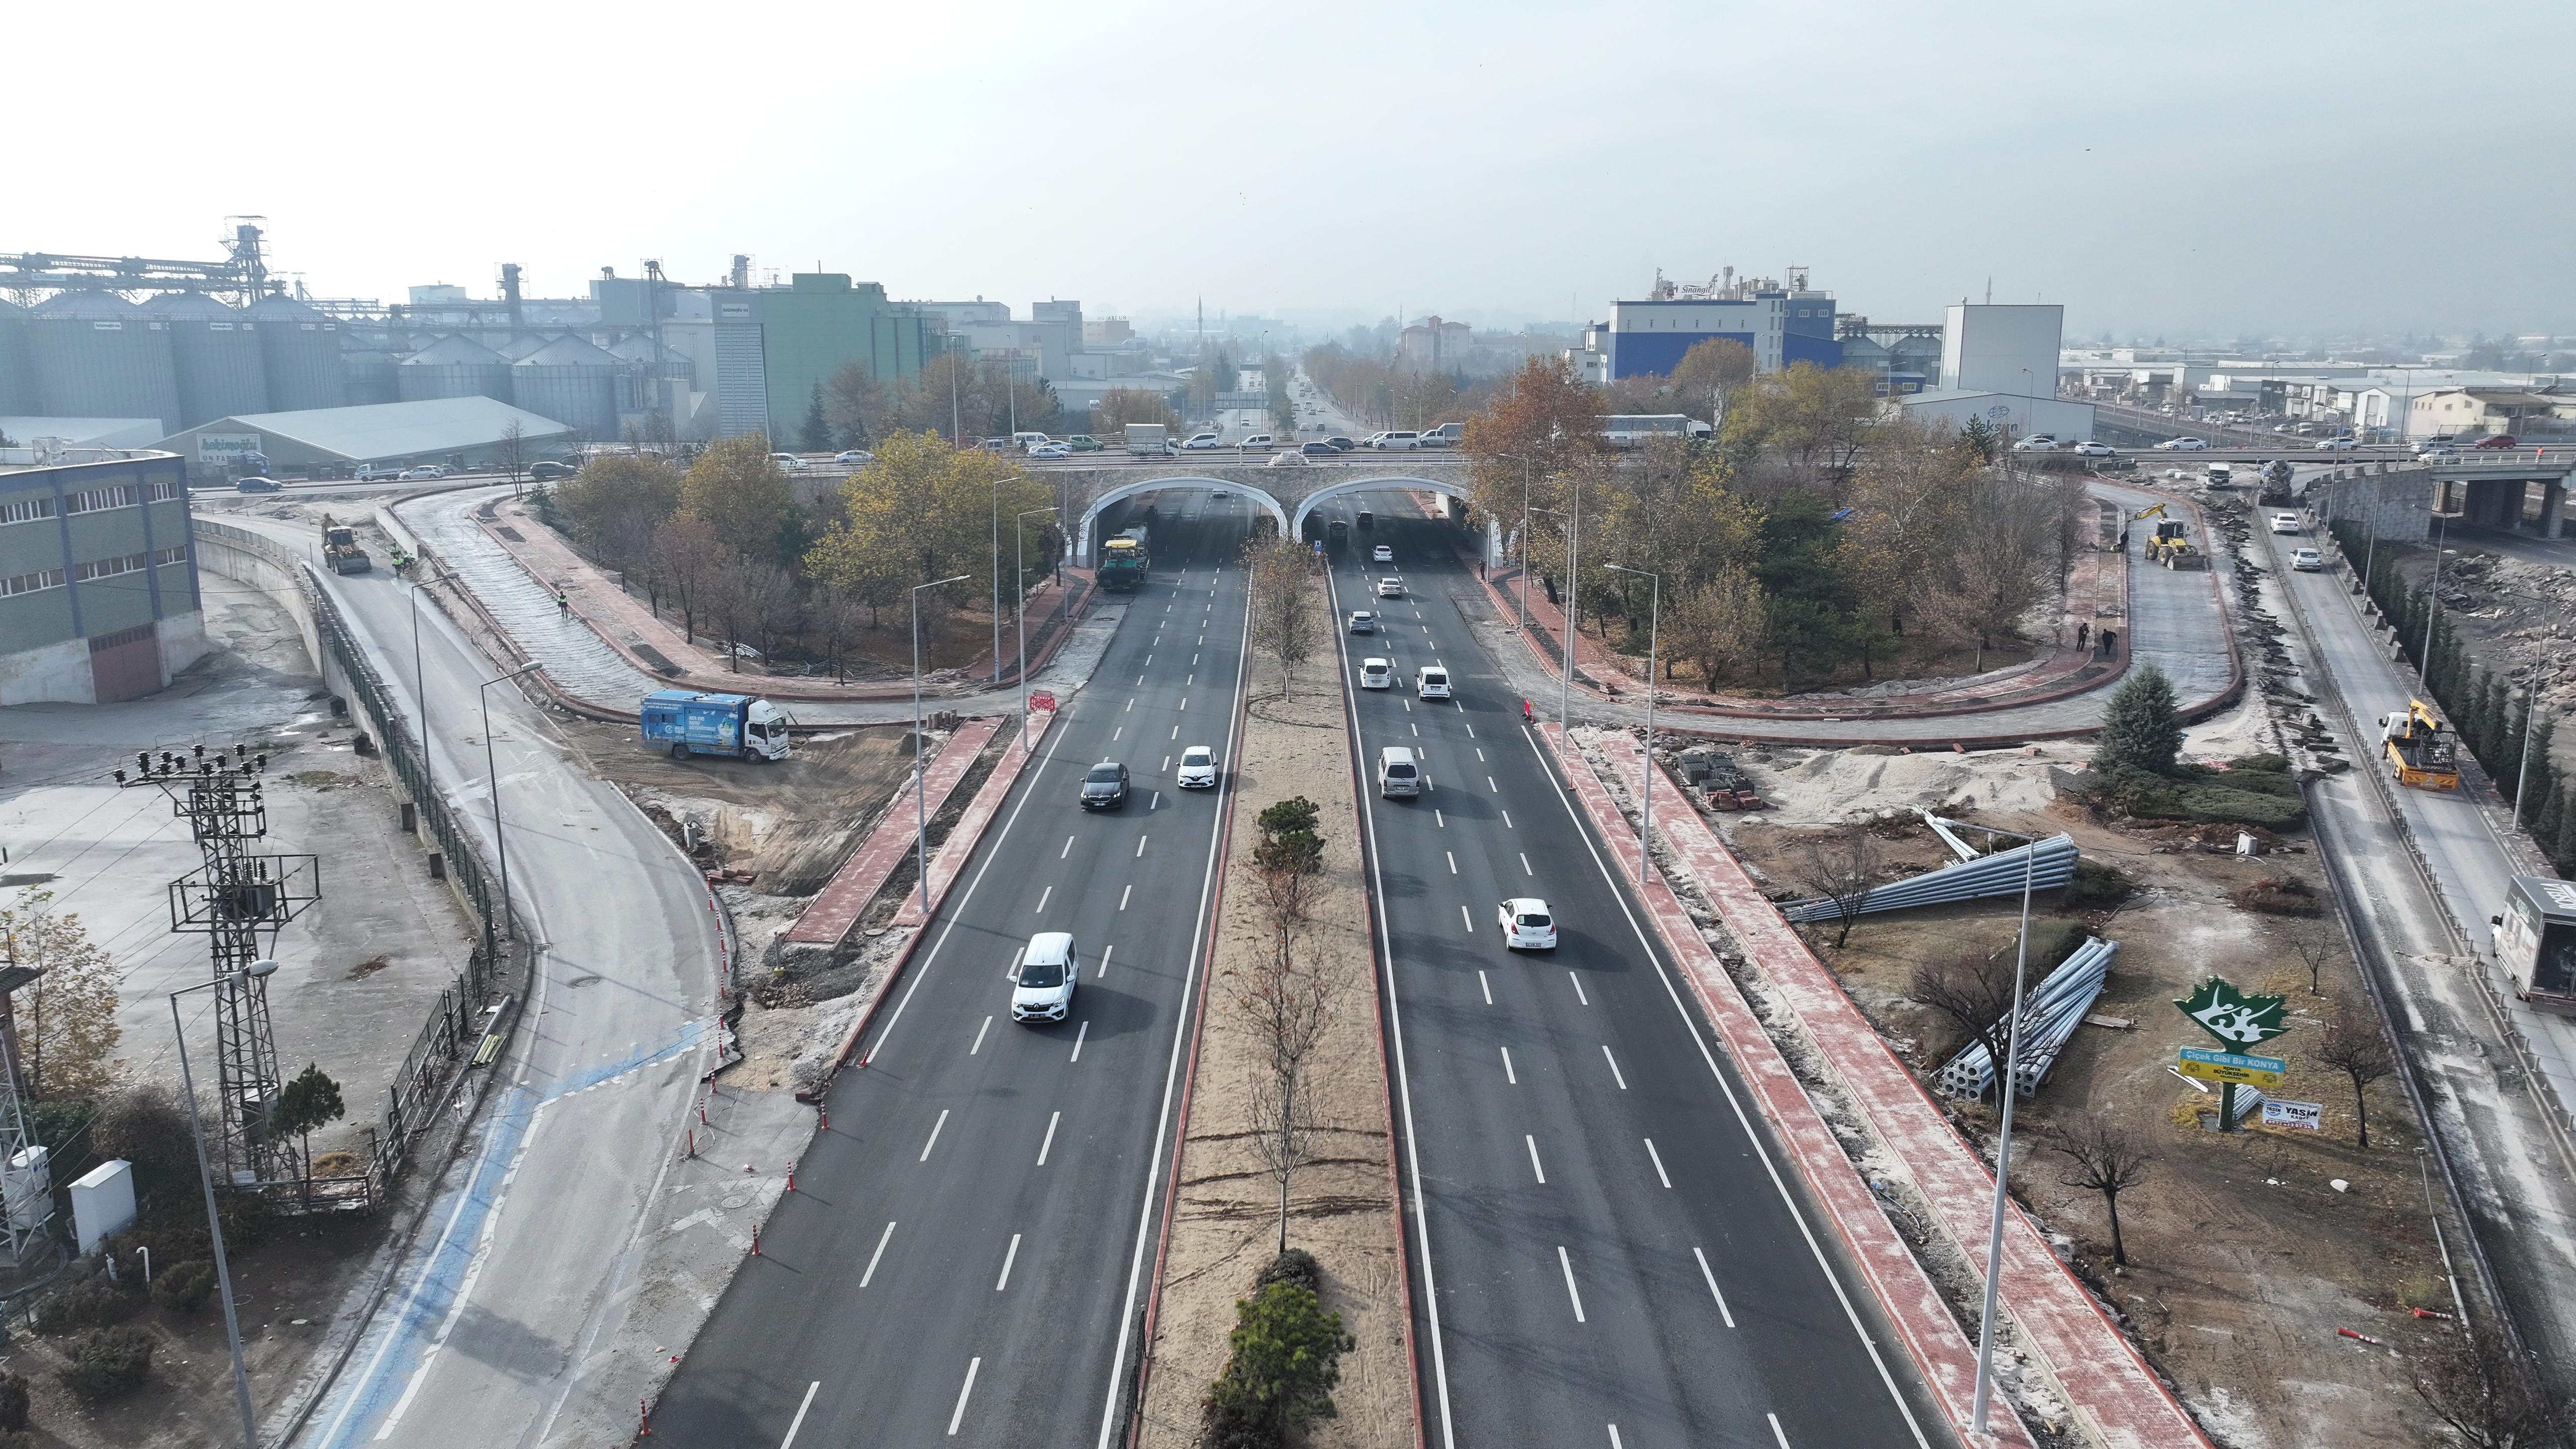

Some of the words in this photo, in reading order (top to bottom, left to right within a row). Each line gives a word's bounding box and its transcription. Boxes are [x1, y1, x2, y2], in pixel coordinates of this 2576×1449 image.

[1681, 286, 1711, 294] Sinangil
[202, 438, 258, 453] hekimoğlu
[2186, 1051, 2210, 1060] Çiçek
[2213, 1054, 2230, 1063] Gibi
[2233, 1057, 2245, 1065] Bir
[2247, 1059, 2279, 1070] KONYA
